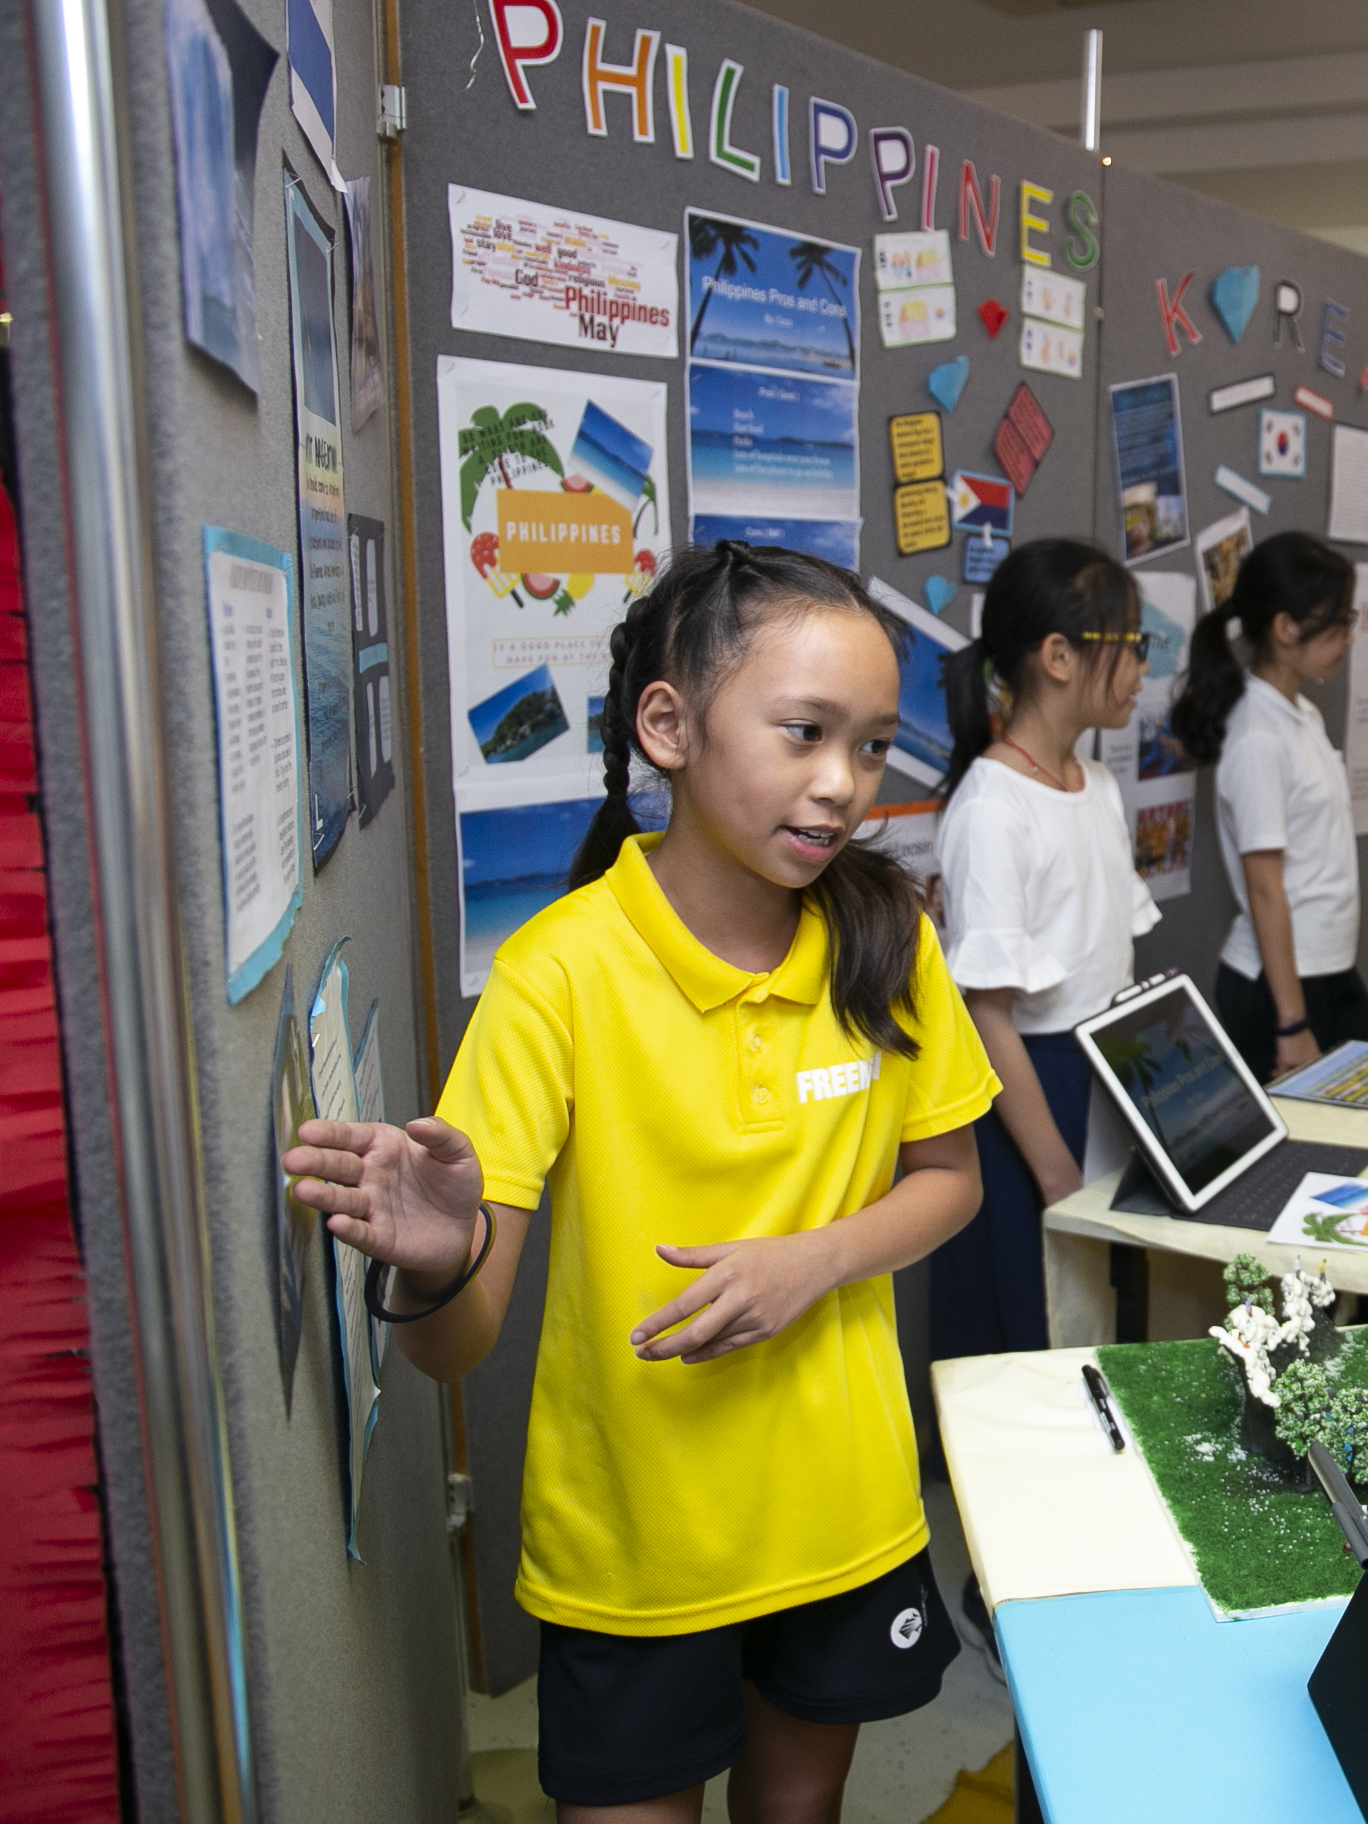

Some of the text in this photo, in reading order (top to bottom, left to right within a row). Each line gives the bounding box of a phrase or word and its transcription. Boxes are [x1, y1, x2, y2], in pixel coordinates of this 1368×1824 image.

[490, 0, 1098, 270] PHILIPPINES
[515, 269, 538, 287] God
[702, 275, 847, 317] Philippines Pros and Cons
[565, 285, 670, 327] Philippines
[579, 312, 619, 348] May
[506, 521, 621, 544] PHILIPPINES
